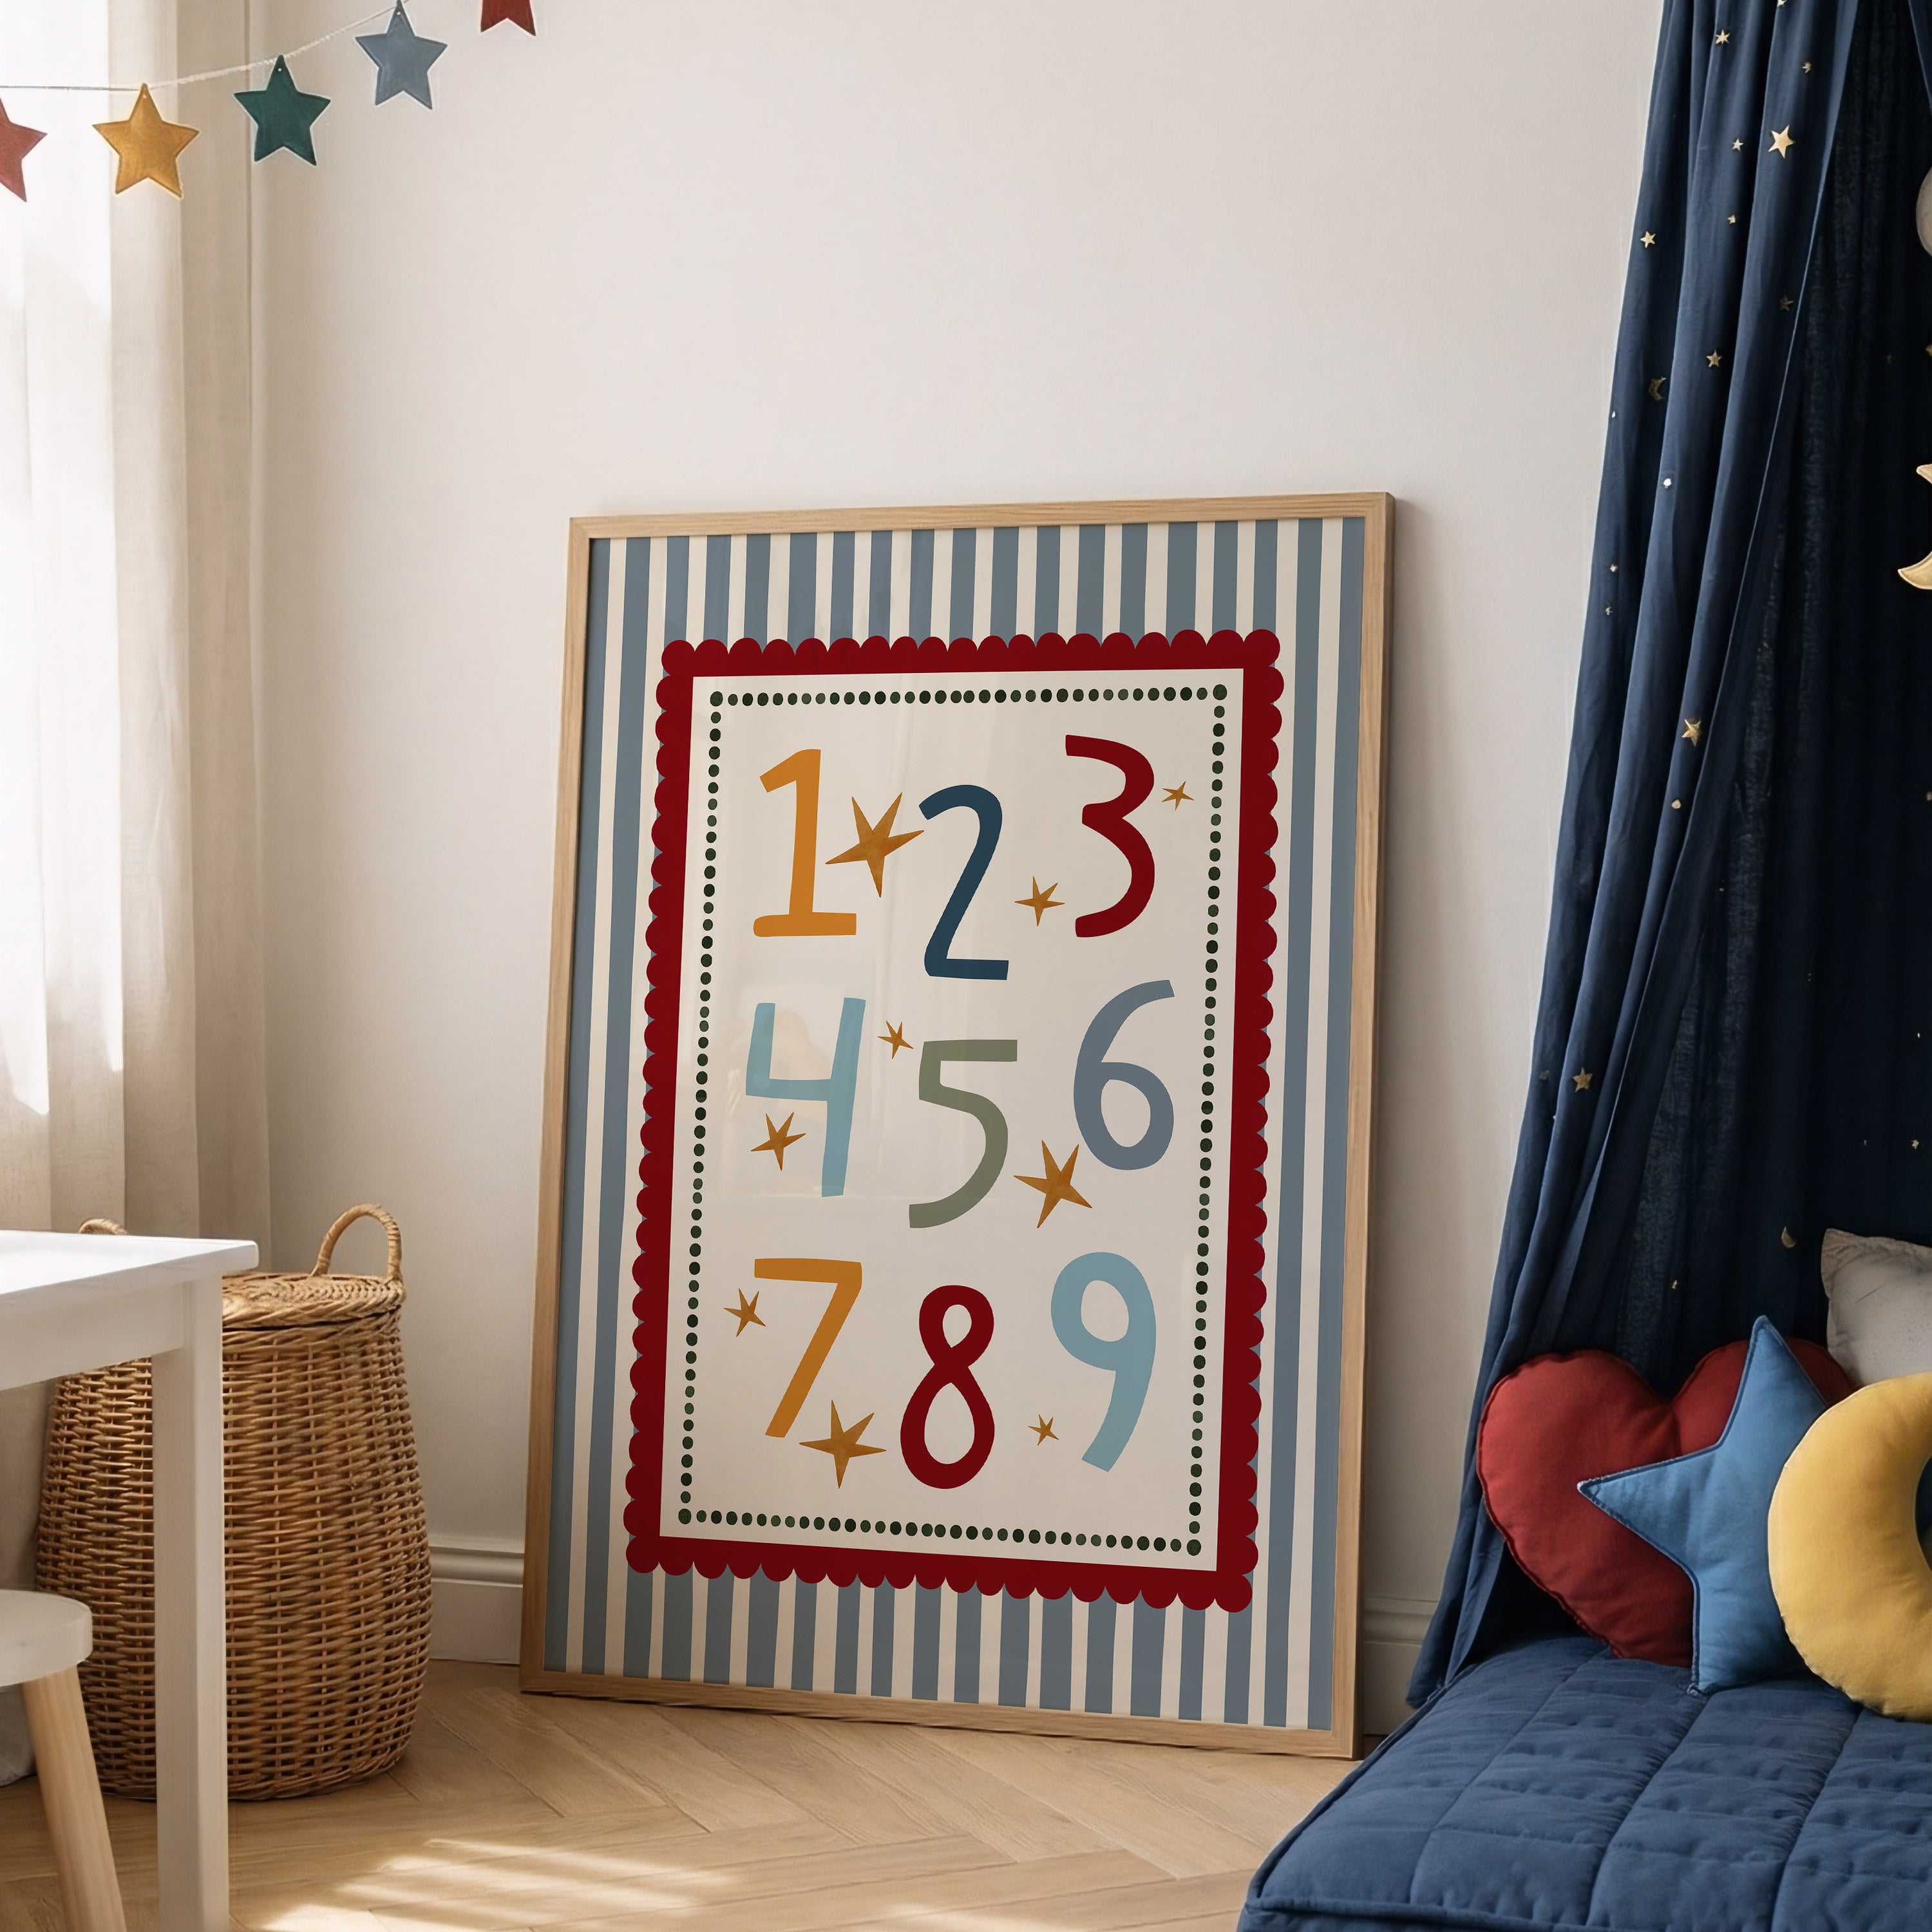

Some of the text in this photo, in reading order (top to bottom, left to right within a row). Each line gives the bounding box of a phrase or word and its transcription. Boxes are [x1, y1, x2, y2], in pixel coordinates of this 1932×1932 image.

[753, 734, 1155, 981] 1 2 3
[745, 979, 1175, 1229] 4 5 6
[753, 1251, 1157, 1490] 7 8 9
